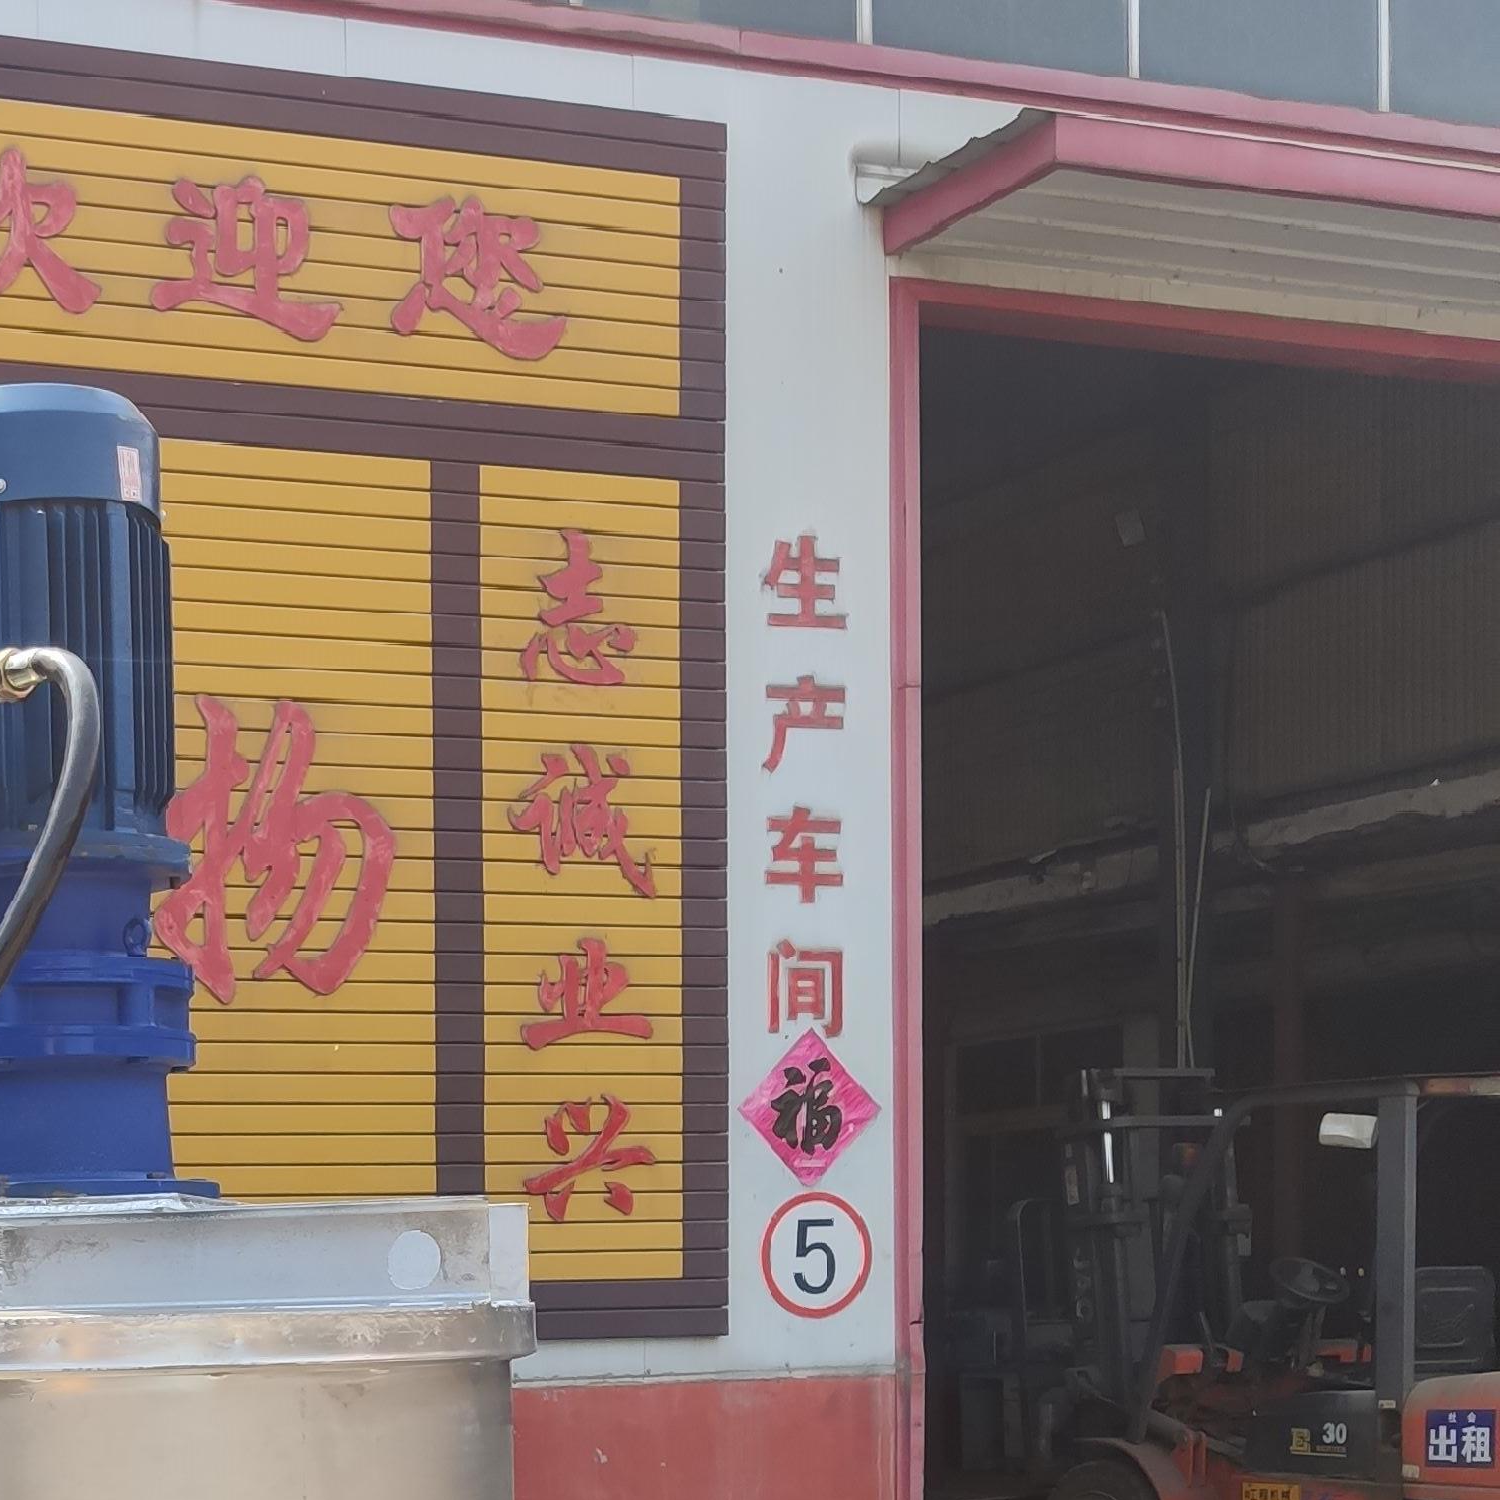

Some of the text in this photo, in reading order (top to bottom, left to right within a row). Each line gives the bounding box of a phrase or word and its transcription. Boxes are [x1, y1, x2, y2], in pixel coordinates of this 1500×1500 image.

[762, 534, 848, 1038] 生产车间
[770, 1057, 842, 1155] 福
[793, 1218, 836, 1294] 5
[1322, 1422, 1347, 1444] 30
[1428, 1425, 1492, 1463] 出租
